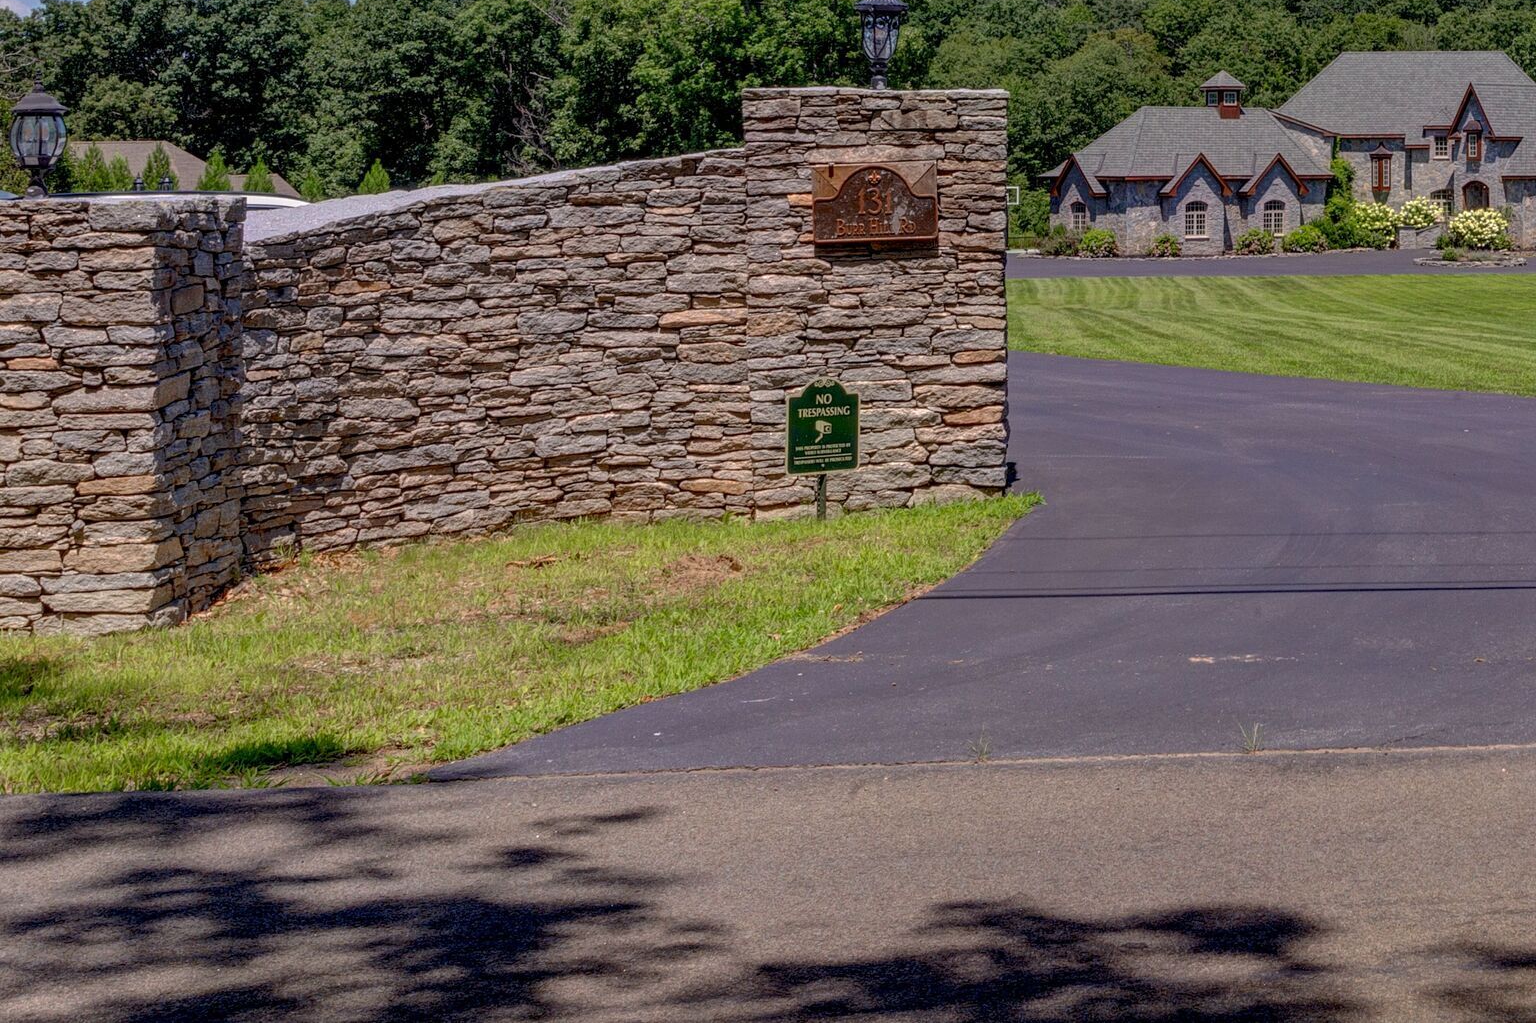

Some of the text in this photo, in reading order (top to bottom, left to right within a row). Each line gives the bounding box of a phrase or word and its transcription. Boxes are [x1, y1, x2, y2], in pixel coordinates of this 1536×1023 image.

[858, 185, 892, 216] 131
[815, 393, 832, 405] NO
[797, 405, 850, 419] TRESPASSING
